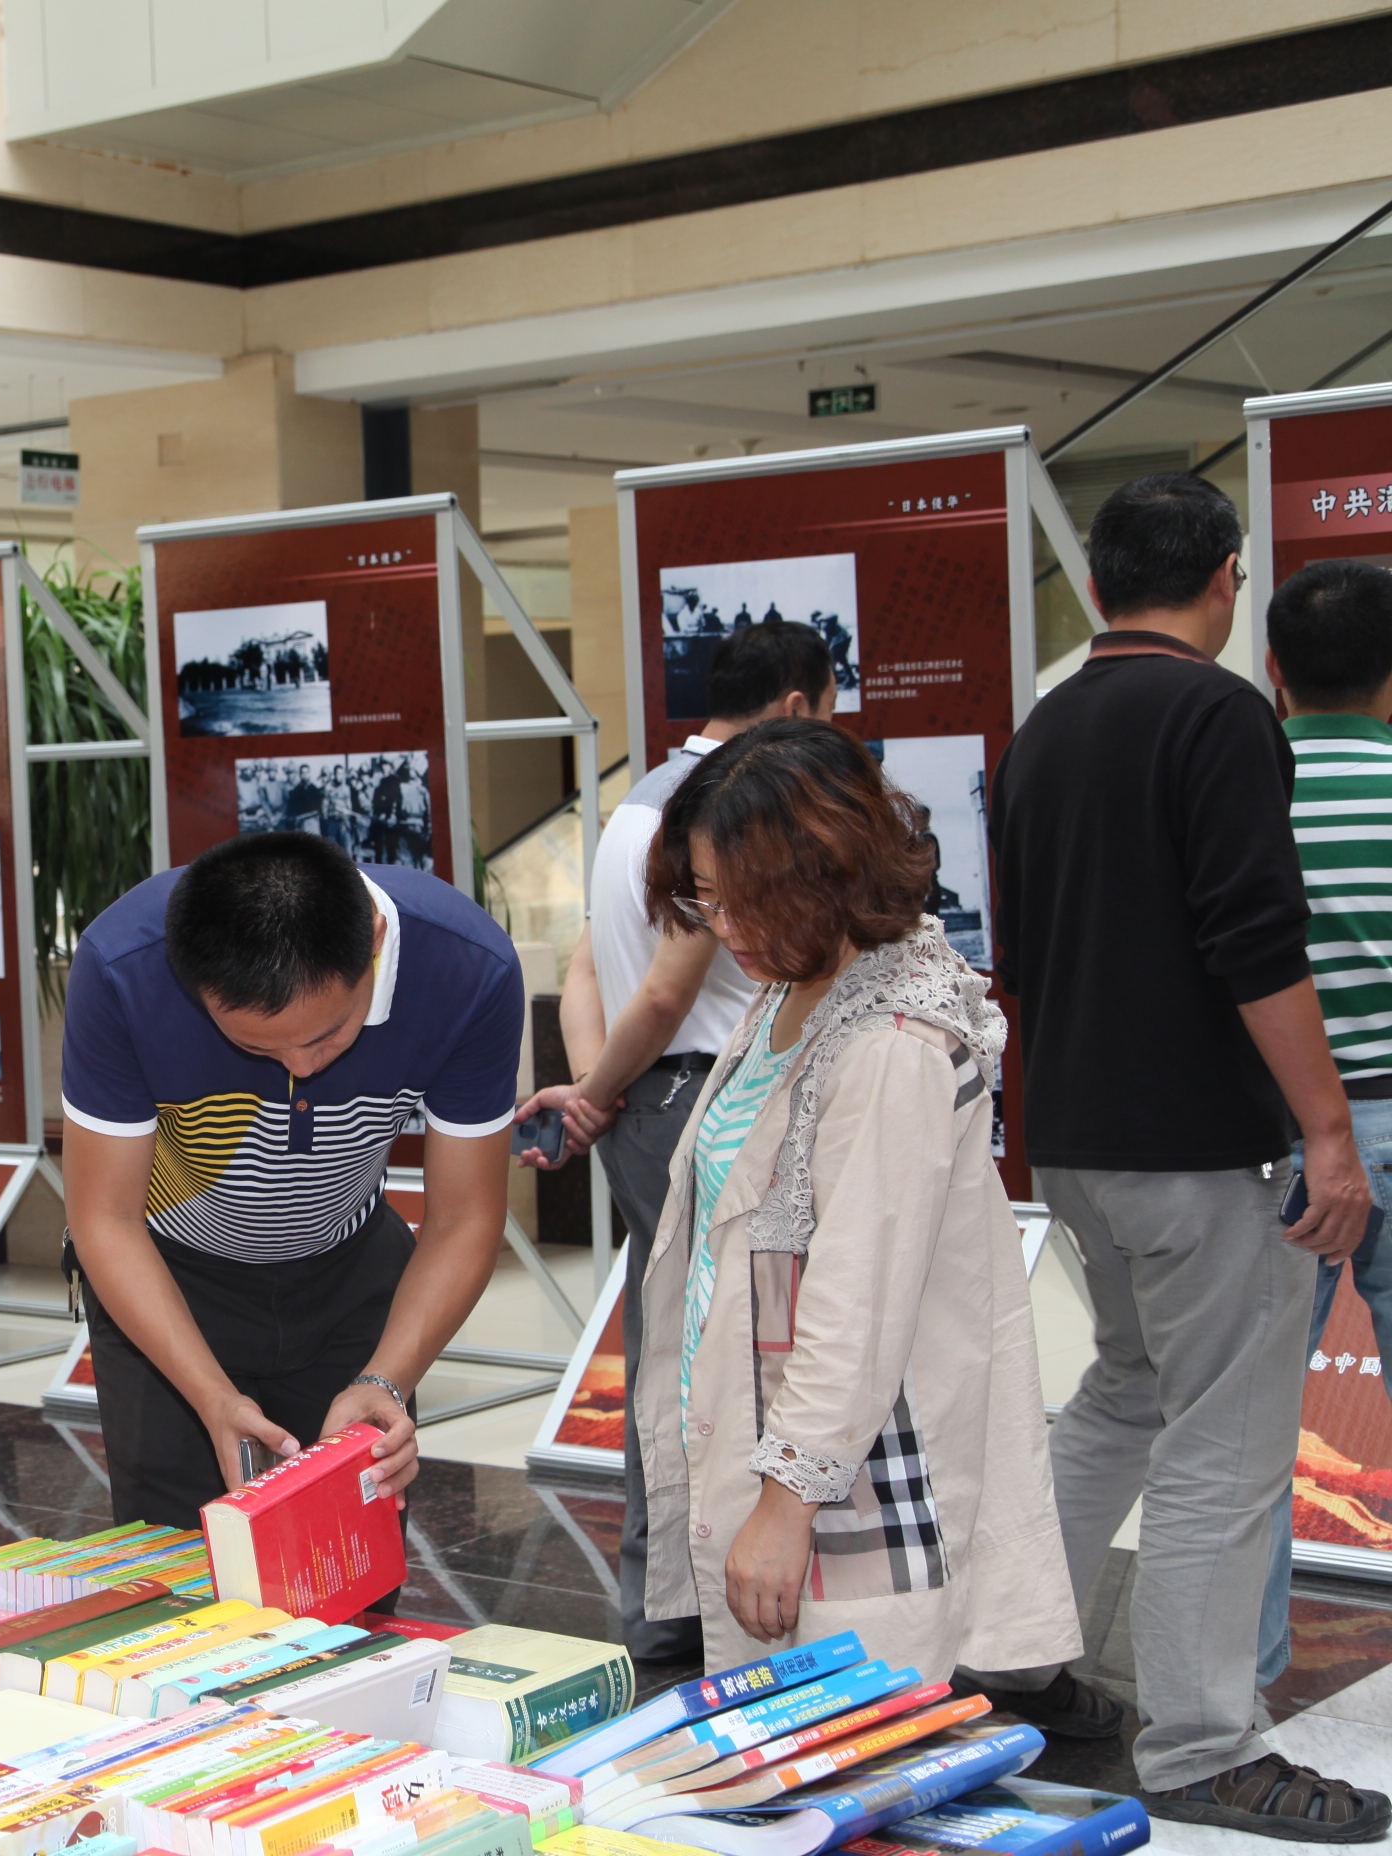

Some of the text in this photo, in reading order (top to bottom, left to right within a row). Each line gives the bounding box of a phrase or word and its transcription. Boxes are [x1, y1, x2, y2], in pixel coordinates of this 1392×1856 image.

[536, 1689, 599, 1731] 古代汉语词典
